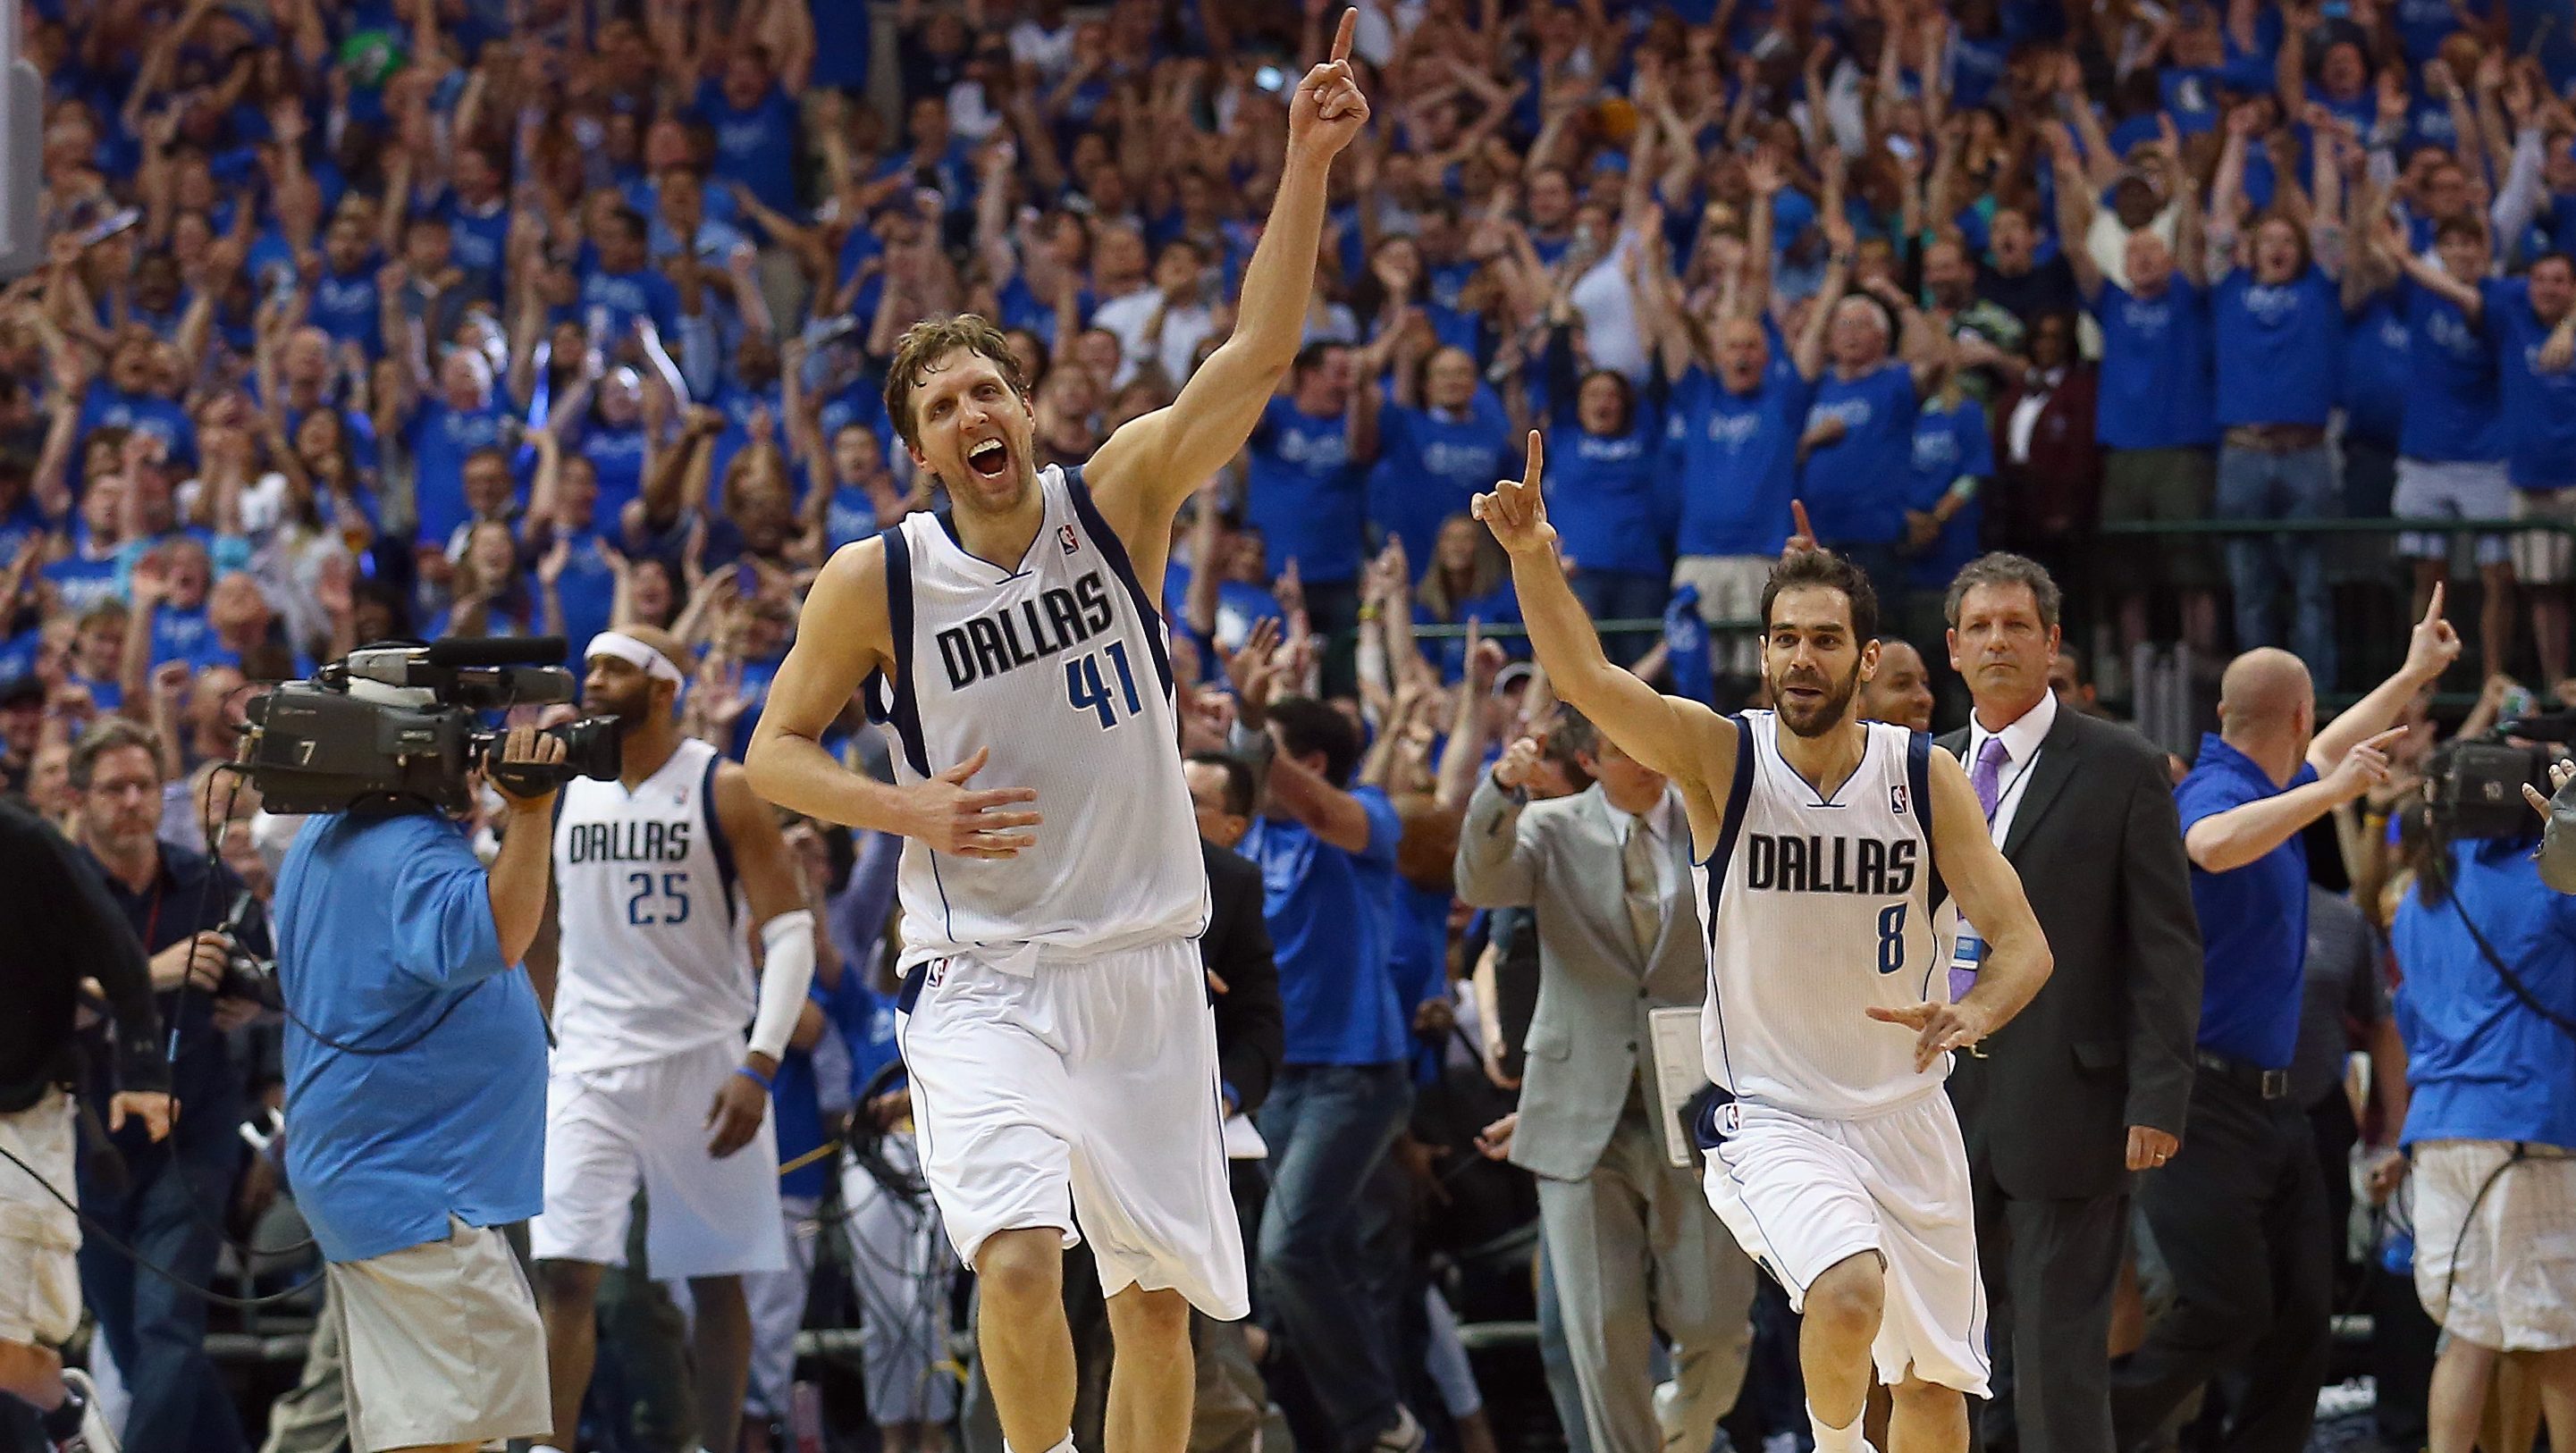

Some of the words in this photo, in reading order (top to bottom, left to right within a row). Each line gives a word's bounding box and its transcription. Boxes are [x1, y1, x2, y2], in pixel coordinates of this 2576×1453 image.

[936, 571, 1113, 692] DALLAS
[1064, 639, 1143, 731] 41
[300, 741, 316, 766] 7
[2483, 781, 2503, 802] 10
[570, 821, 691, 864] DALLAS
[1748, 834, 1916, 894] DALLAS
[628, 872, 690, 925] 25
[1876, 901, 1908, 977] 8
